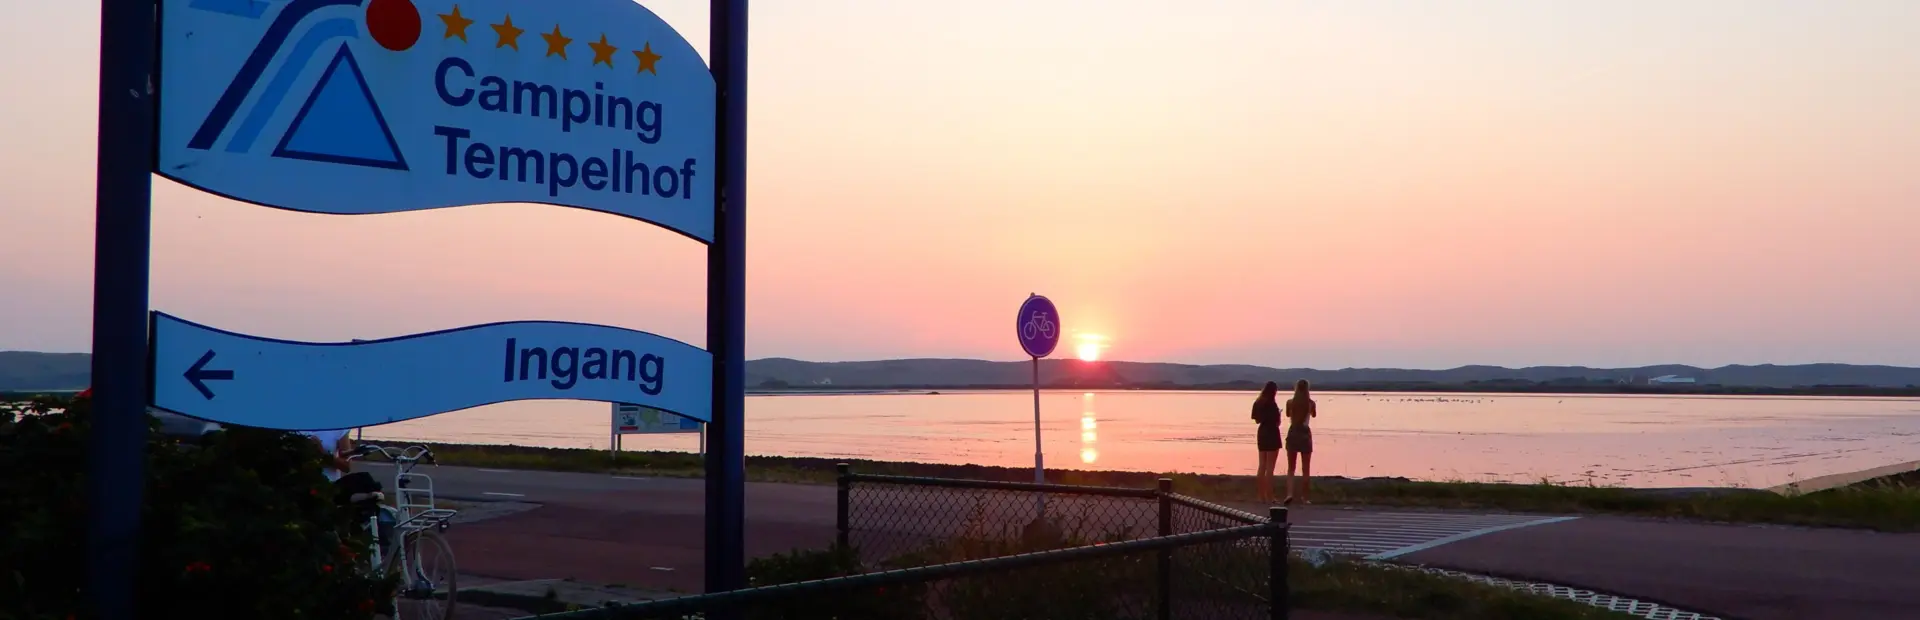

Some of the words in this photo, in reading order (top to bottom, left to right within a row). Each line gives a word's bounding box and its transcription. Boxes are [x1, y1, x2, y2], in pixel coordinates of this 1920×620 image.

[435, 57, 663, 144] Camping
[434, 126, 697, 200] Tempelhof
[504, 337, 665, 396] Ingang
